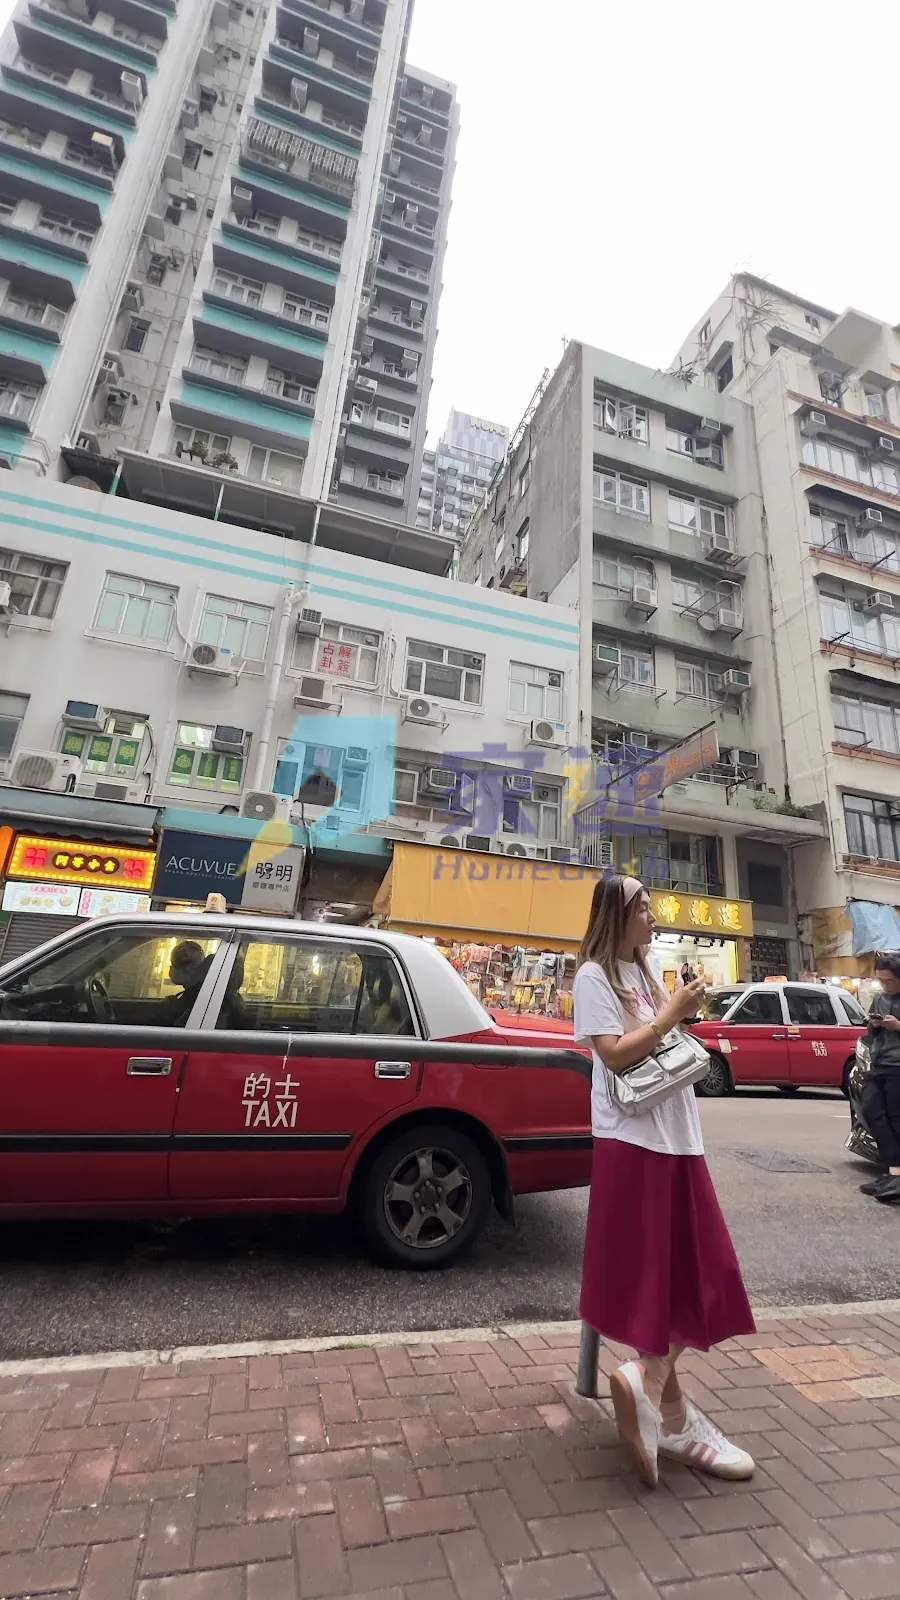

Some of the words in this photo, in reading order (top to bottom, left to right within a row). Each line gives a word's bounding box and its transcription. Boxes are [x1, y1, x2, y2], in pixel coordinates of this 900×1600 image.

[166, 855, 237, 876] ACUVUE
[243, 1072, 300, 1099] 的士
[241, 1100, 298, 1128] TAXI
